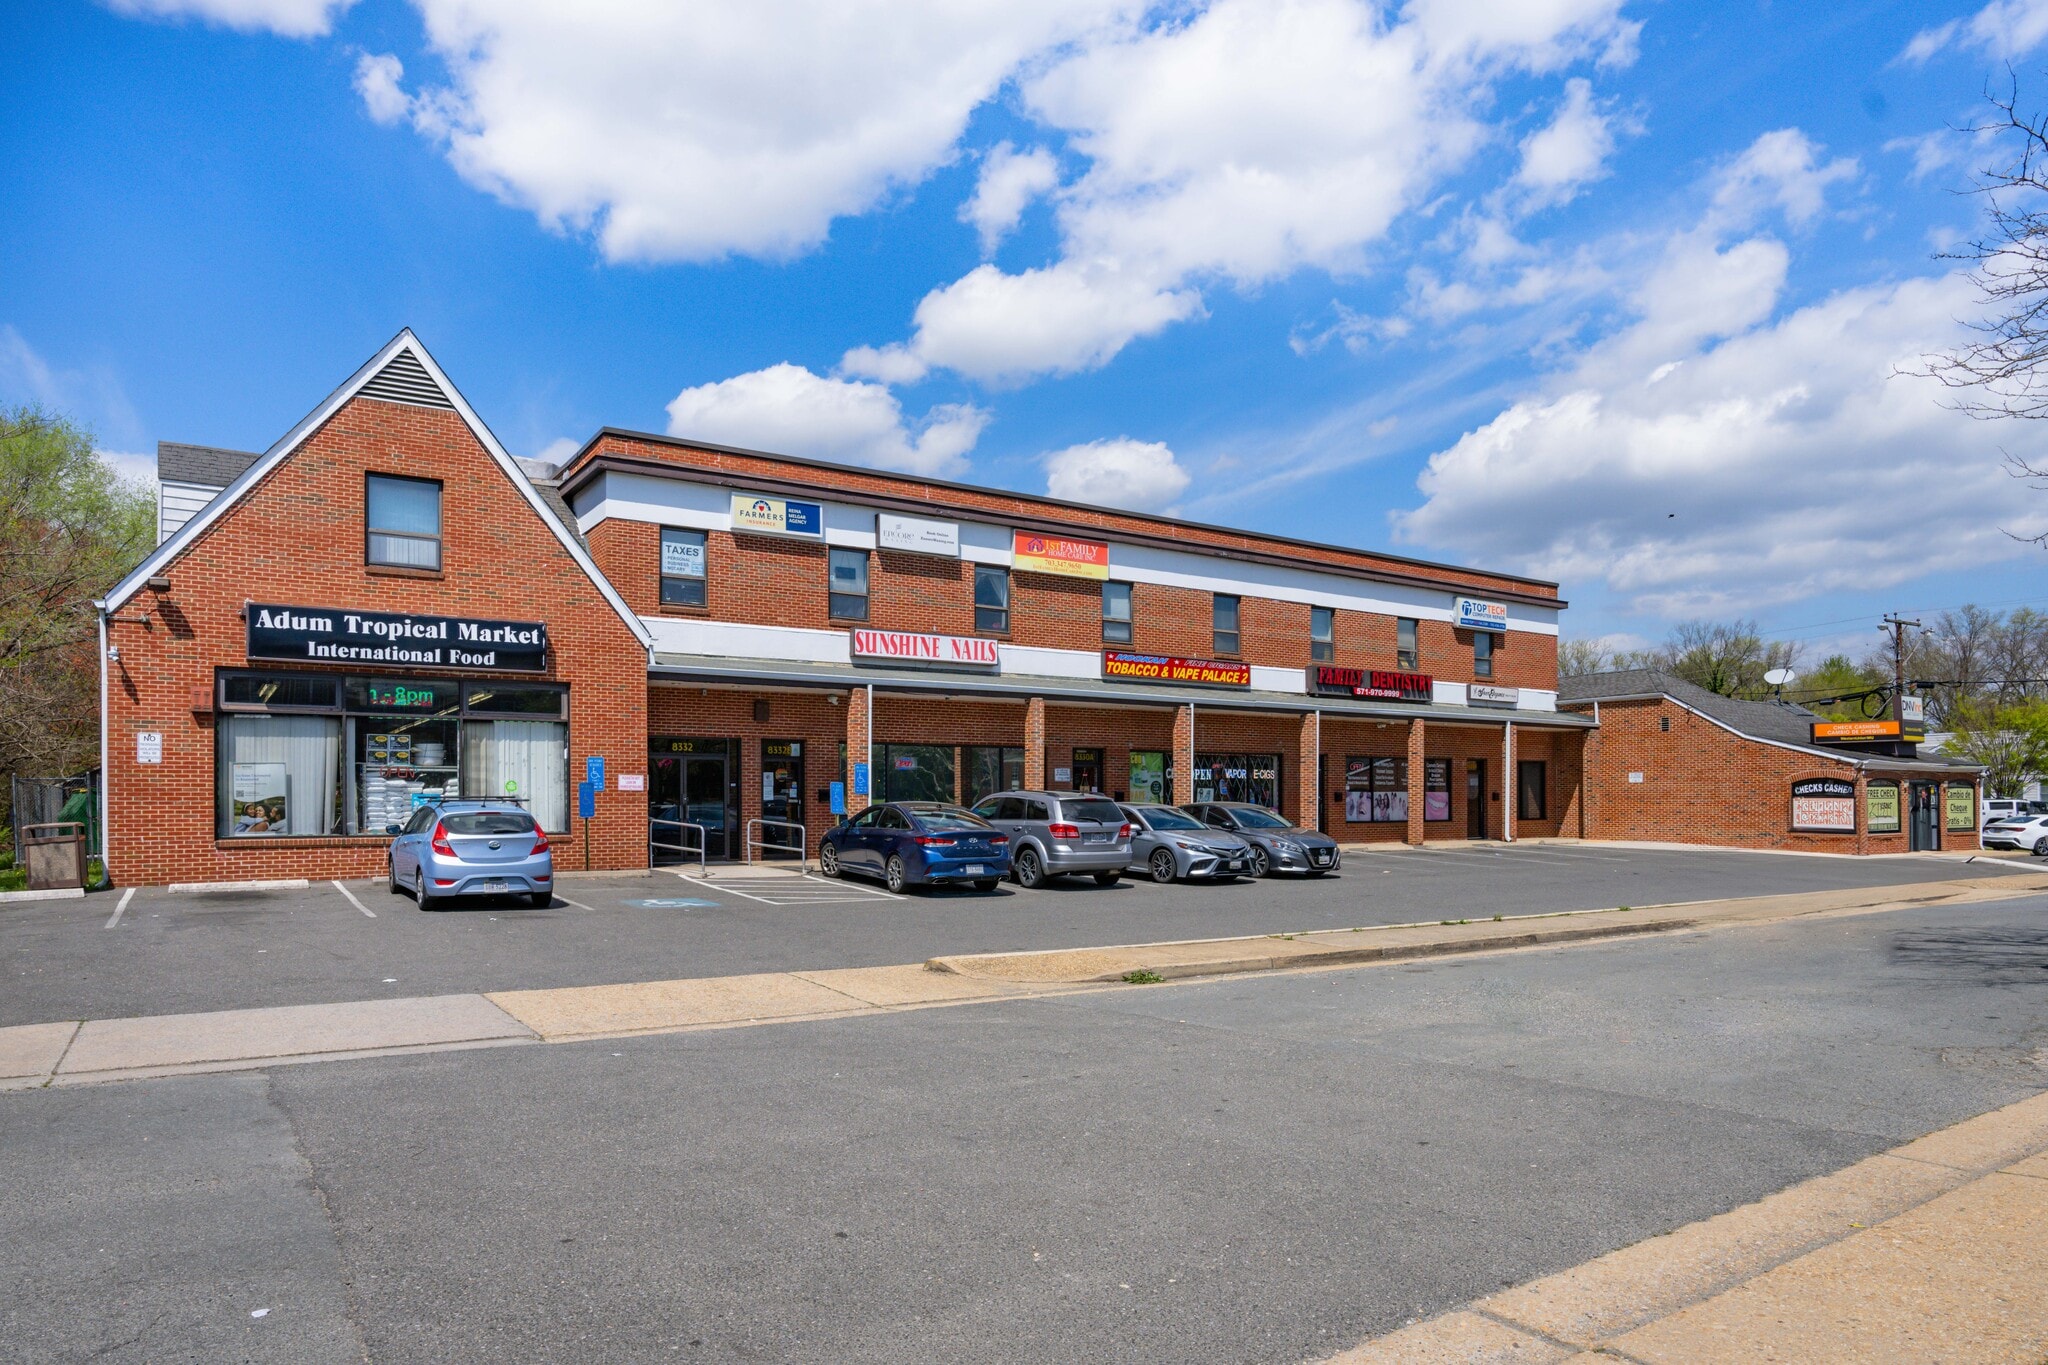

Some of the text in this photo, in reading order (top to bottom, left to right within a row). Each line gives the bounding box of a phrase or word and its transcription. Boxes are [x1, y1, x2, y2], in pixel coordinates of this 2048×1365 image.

[740, 509, 784, 521] FARMERS
[747, 519, 776, 527] INSURANCE
[665, 544, 699, 557] TAXES
[1048, 549, 1067, 558] HOME
[1067, 552, 1084, 560] CARE
[255, 609, 539, 644] Adum Tropical Market
[855, 631, 996, 662] SUNSHINE NAILS
[308, 641, 495, 666] International Food
[1115, 653, 1168, 665] HOOKAH
[1208, 661, 1241, 670] CIGARS
[1106, 661, 1249, 684] TOBACCO & VAPE PALACE 2
[1318, 666, 1433, 691] FAMILY DENTISTRY
[395, 687, 434, 705] 8pm
[1356, 687, 1400, 698] 571-970-9999
[672, 742, 693, 752] 8332
[380, 766, 416, 778] OPEN
[1193, 768, 1275, 780] PEN VAPOR E-CIGS
[1795, 784, 1823, 795] CHECKS
[1867, 789, 1896, 798] FREE CHECK
[1947, 789, 1971, 799] Cambio de
[1950, 803, 1968, 812] Cheque
